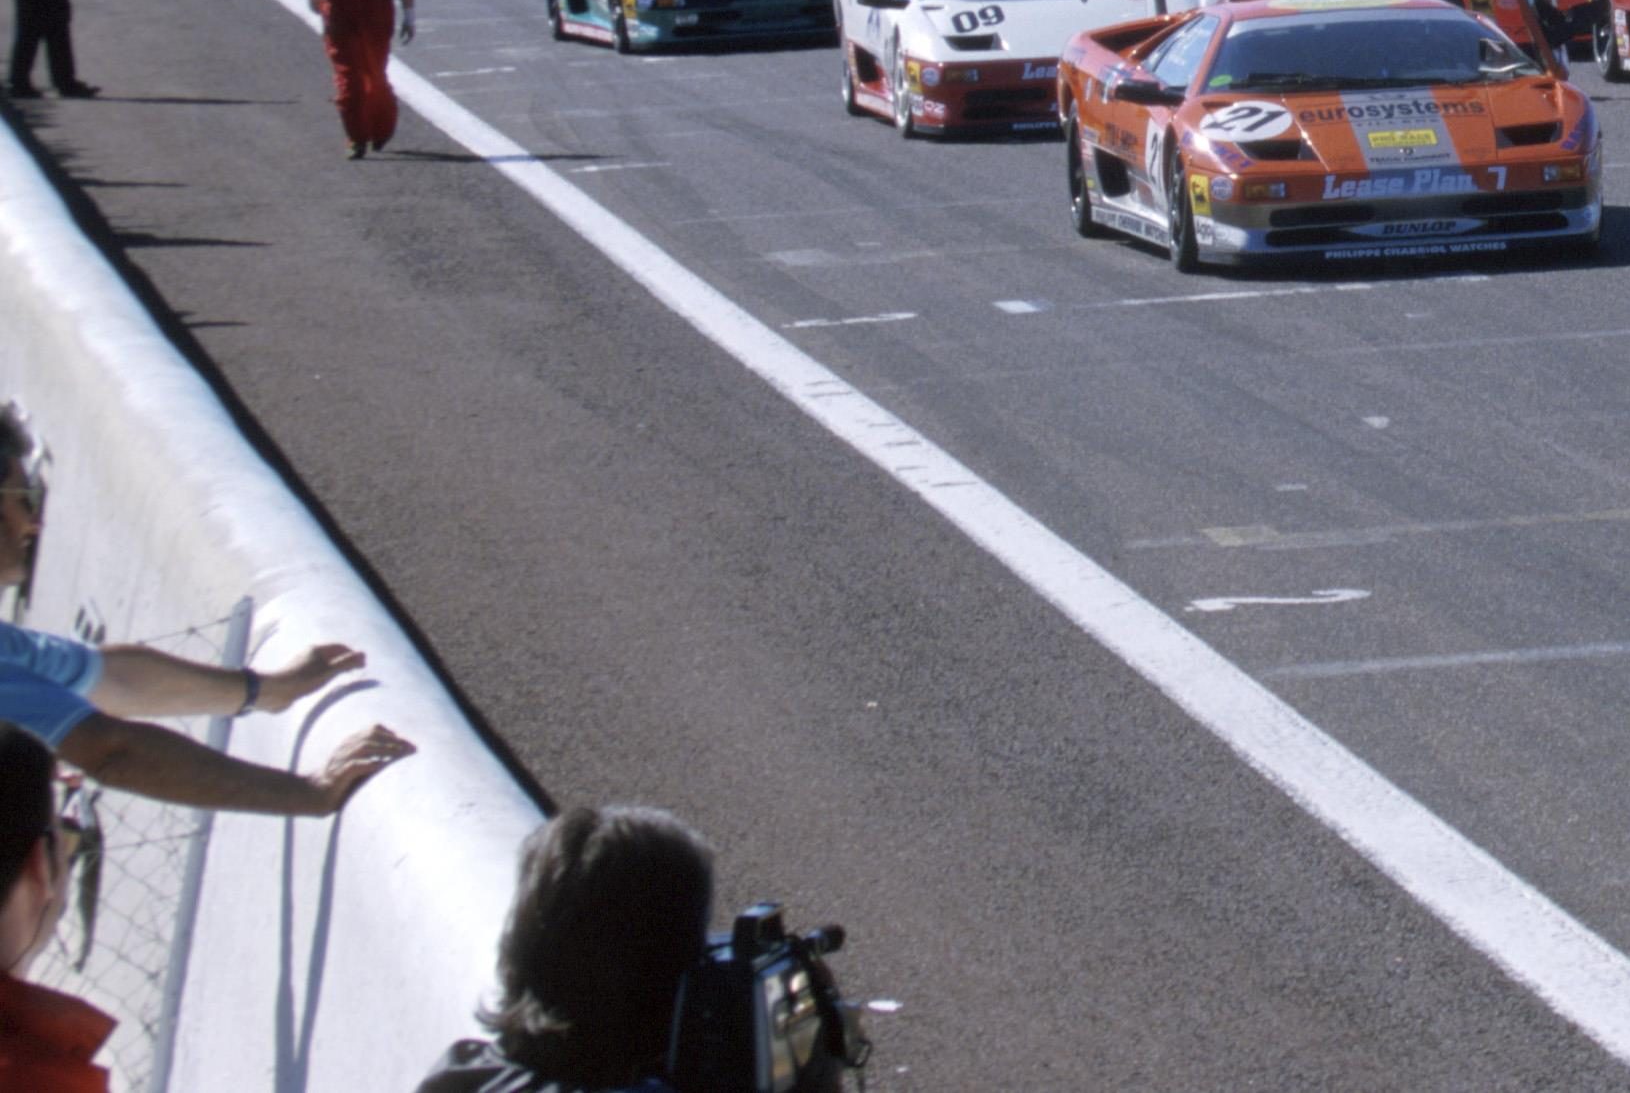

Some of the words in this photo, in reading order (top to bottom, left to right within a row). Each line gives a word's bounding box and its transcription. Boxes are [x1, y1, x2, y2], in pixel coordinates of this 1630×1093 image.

[952, 5, 1005, 33] 09
[1203, 106, 1287, 132] 21
[1299, 98, 1485, 123] eurosystems
[1322, 175, 1405, 199] Lease
[1411, 169, 1478, 193] Plan
[1382, 220, 1457, 235] DUNLOP
[1325, 248, 1381, 259] PHILIPPE
[1449, 241, 1507, 252] WATCHES
